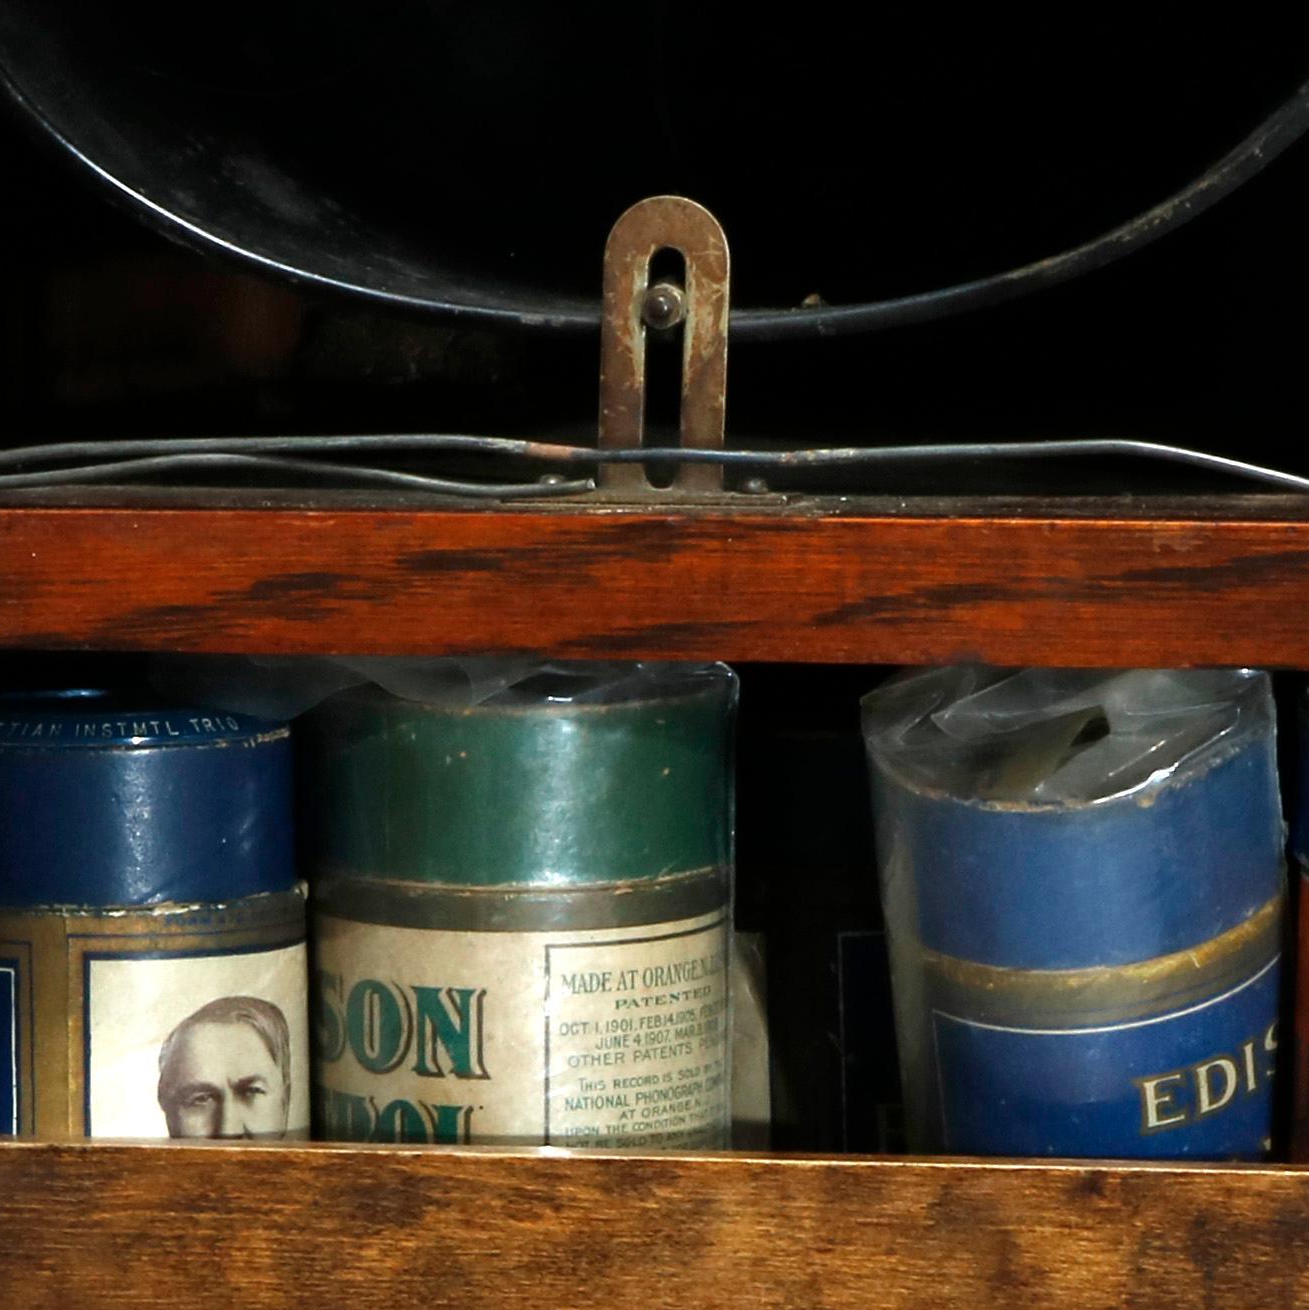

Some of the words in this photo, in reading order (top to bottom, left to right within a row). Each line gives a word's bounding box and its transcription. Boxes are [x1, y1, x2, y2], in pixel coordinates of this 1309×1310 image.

[189, 715, 240, 734] TRIO
[560, 970, 613, 995] MADE
[616, 967, 638, 992] AT
[614, 985, 711, 1010] PATENTED
[595, 1034, 630, 1050] JUNE
[567, 1053, 626, 1069] OTHER
[633, 1042, 693, 1062] PATENTS
[613, 1074, 659, 1090] RECORD
[662, 1072, 672, 1083] IS
[565, 1094, 630, 1112] NATIONAL
[635, 1080, 703, 1106] PHONOGRAPH
[619, 1108, 636, 1121] AT
[606, 1123, 628, 1136] THE
[632, 1115, 686, 1133] CONDITION
